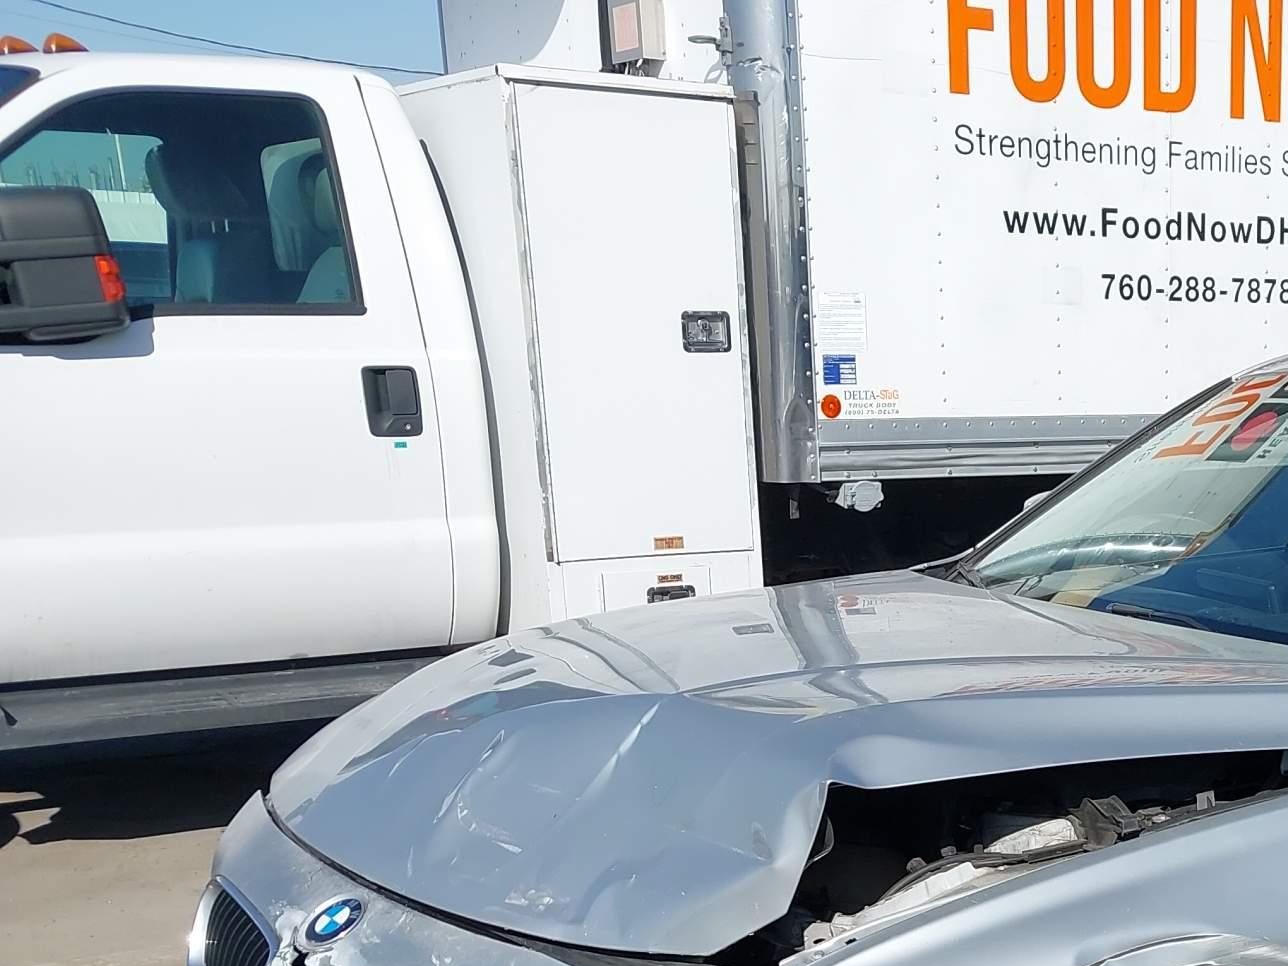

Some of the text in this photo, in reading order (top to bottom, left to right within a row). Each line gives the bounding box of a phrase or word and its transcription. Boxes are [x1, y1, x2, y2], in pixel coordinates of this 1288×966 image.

[947, 0, 1197, 113] FOOD
[954, 124, 1156, 175] Strengthening
[1168, 141, 1272, 176] Families
